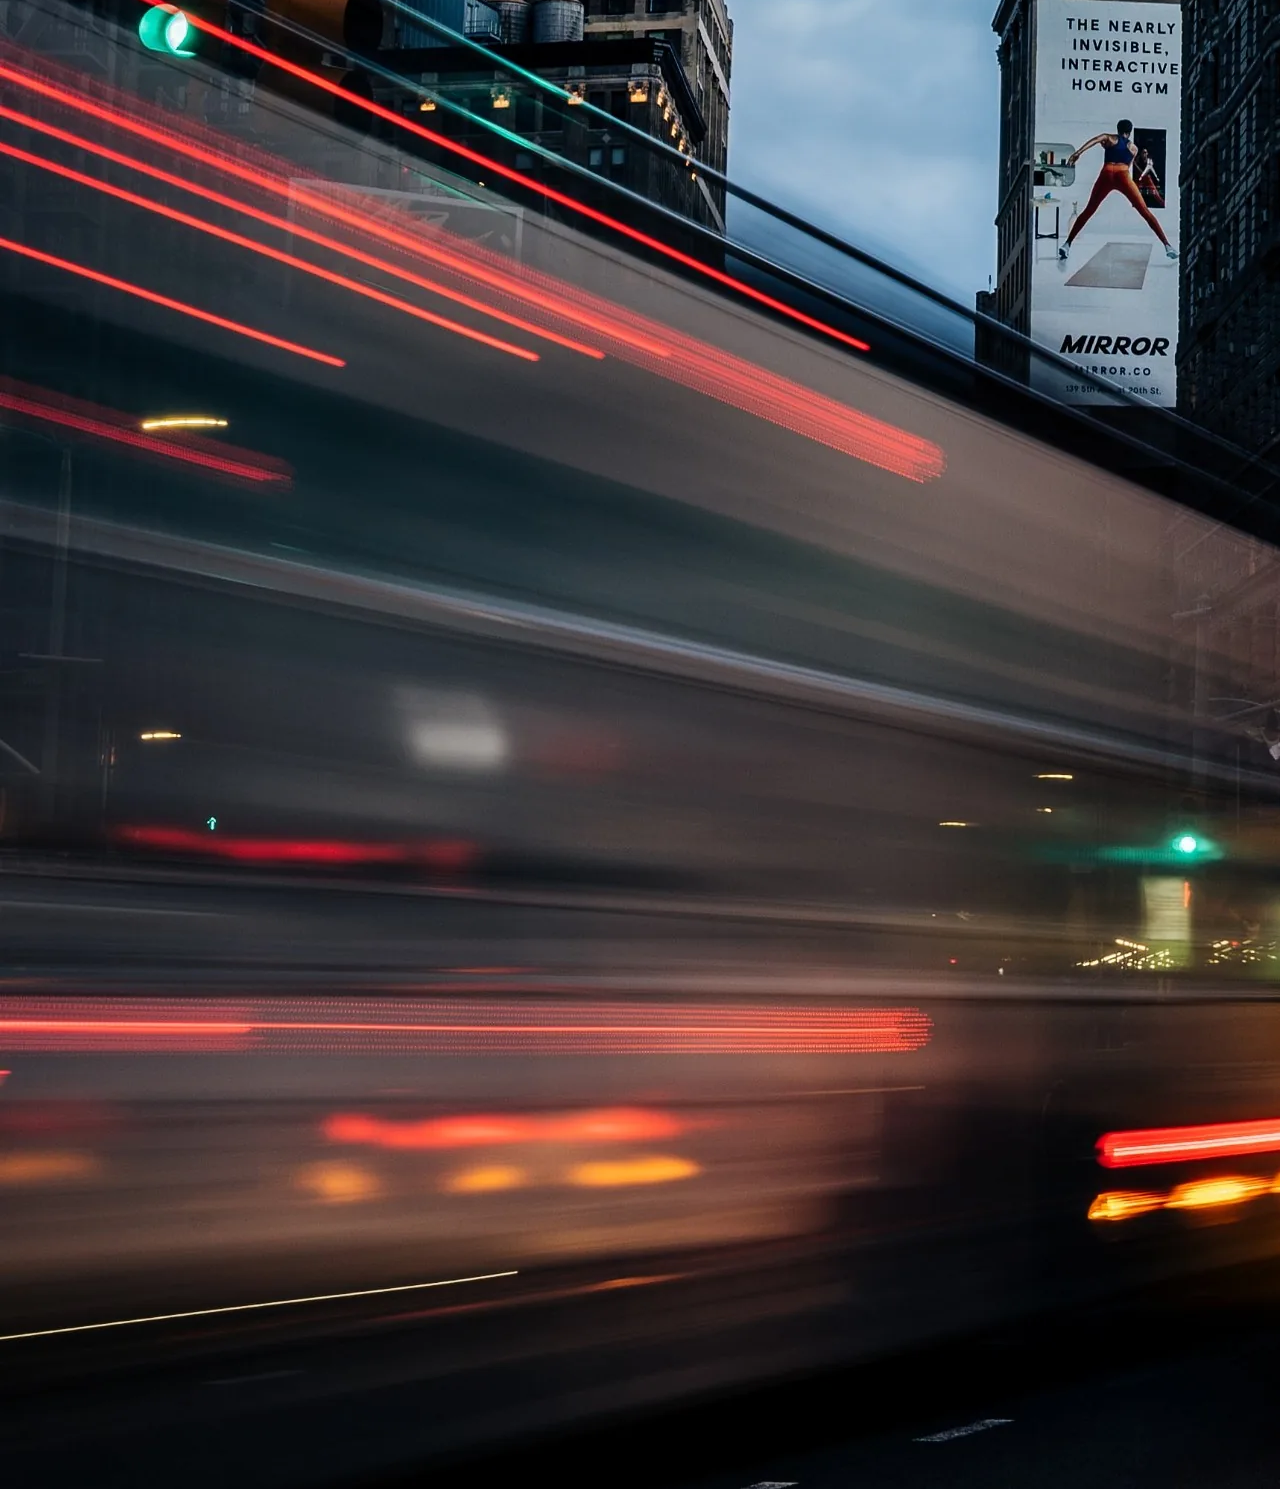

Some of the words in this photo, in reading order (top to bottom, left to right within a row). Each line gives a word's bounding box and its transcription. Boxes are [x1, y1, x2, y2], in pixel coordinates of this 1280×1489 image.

[1066, 18, 1099, 31] THE
[1109, 20, 1176, 34] NEARLY
[1073, 38, 1169, 56] INVISIBLE,
[1061, 58, 1179, 75] INTERACTIVE
[1072, 78, 1123, 93] HOME
[1131, 82, 1168, 95] GYM
[1060, 334, 1170, 356] MIRROR
